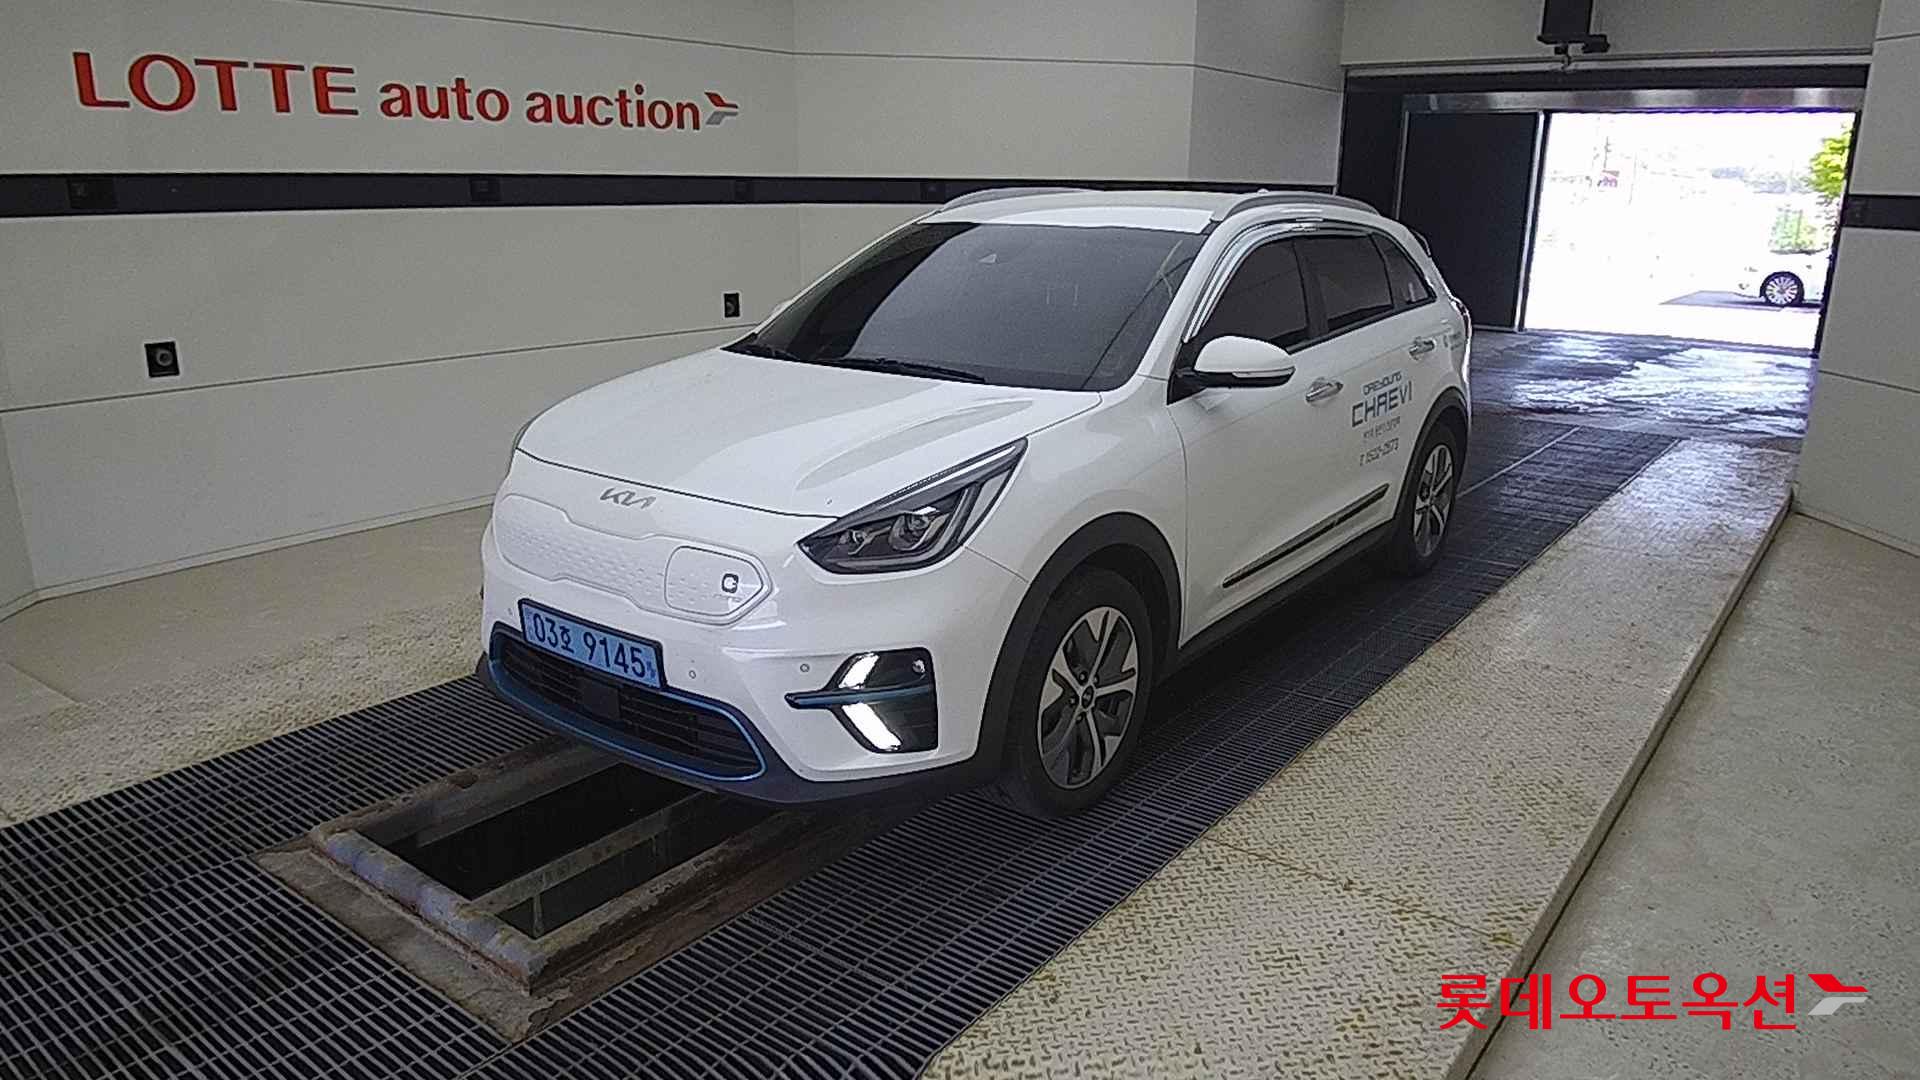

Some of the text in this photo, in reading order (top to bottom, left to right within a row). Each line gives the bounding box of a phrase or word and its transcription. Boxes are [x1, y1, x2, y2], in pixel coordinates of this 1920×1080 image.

[73, 52, 701, 131] LOTTE auto auction
[1352, 380, 1412, 428] CHAEVI
[533, 613, 646, 678] 03호 9145
